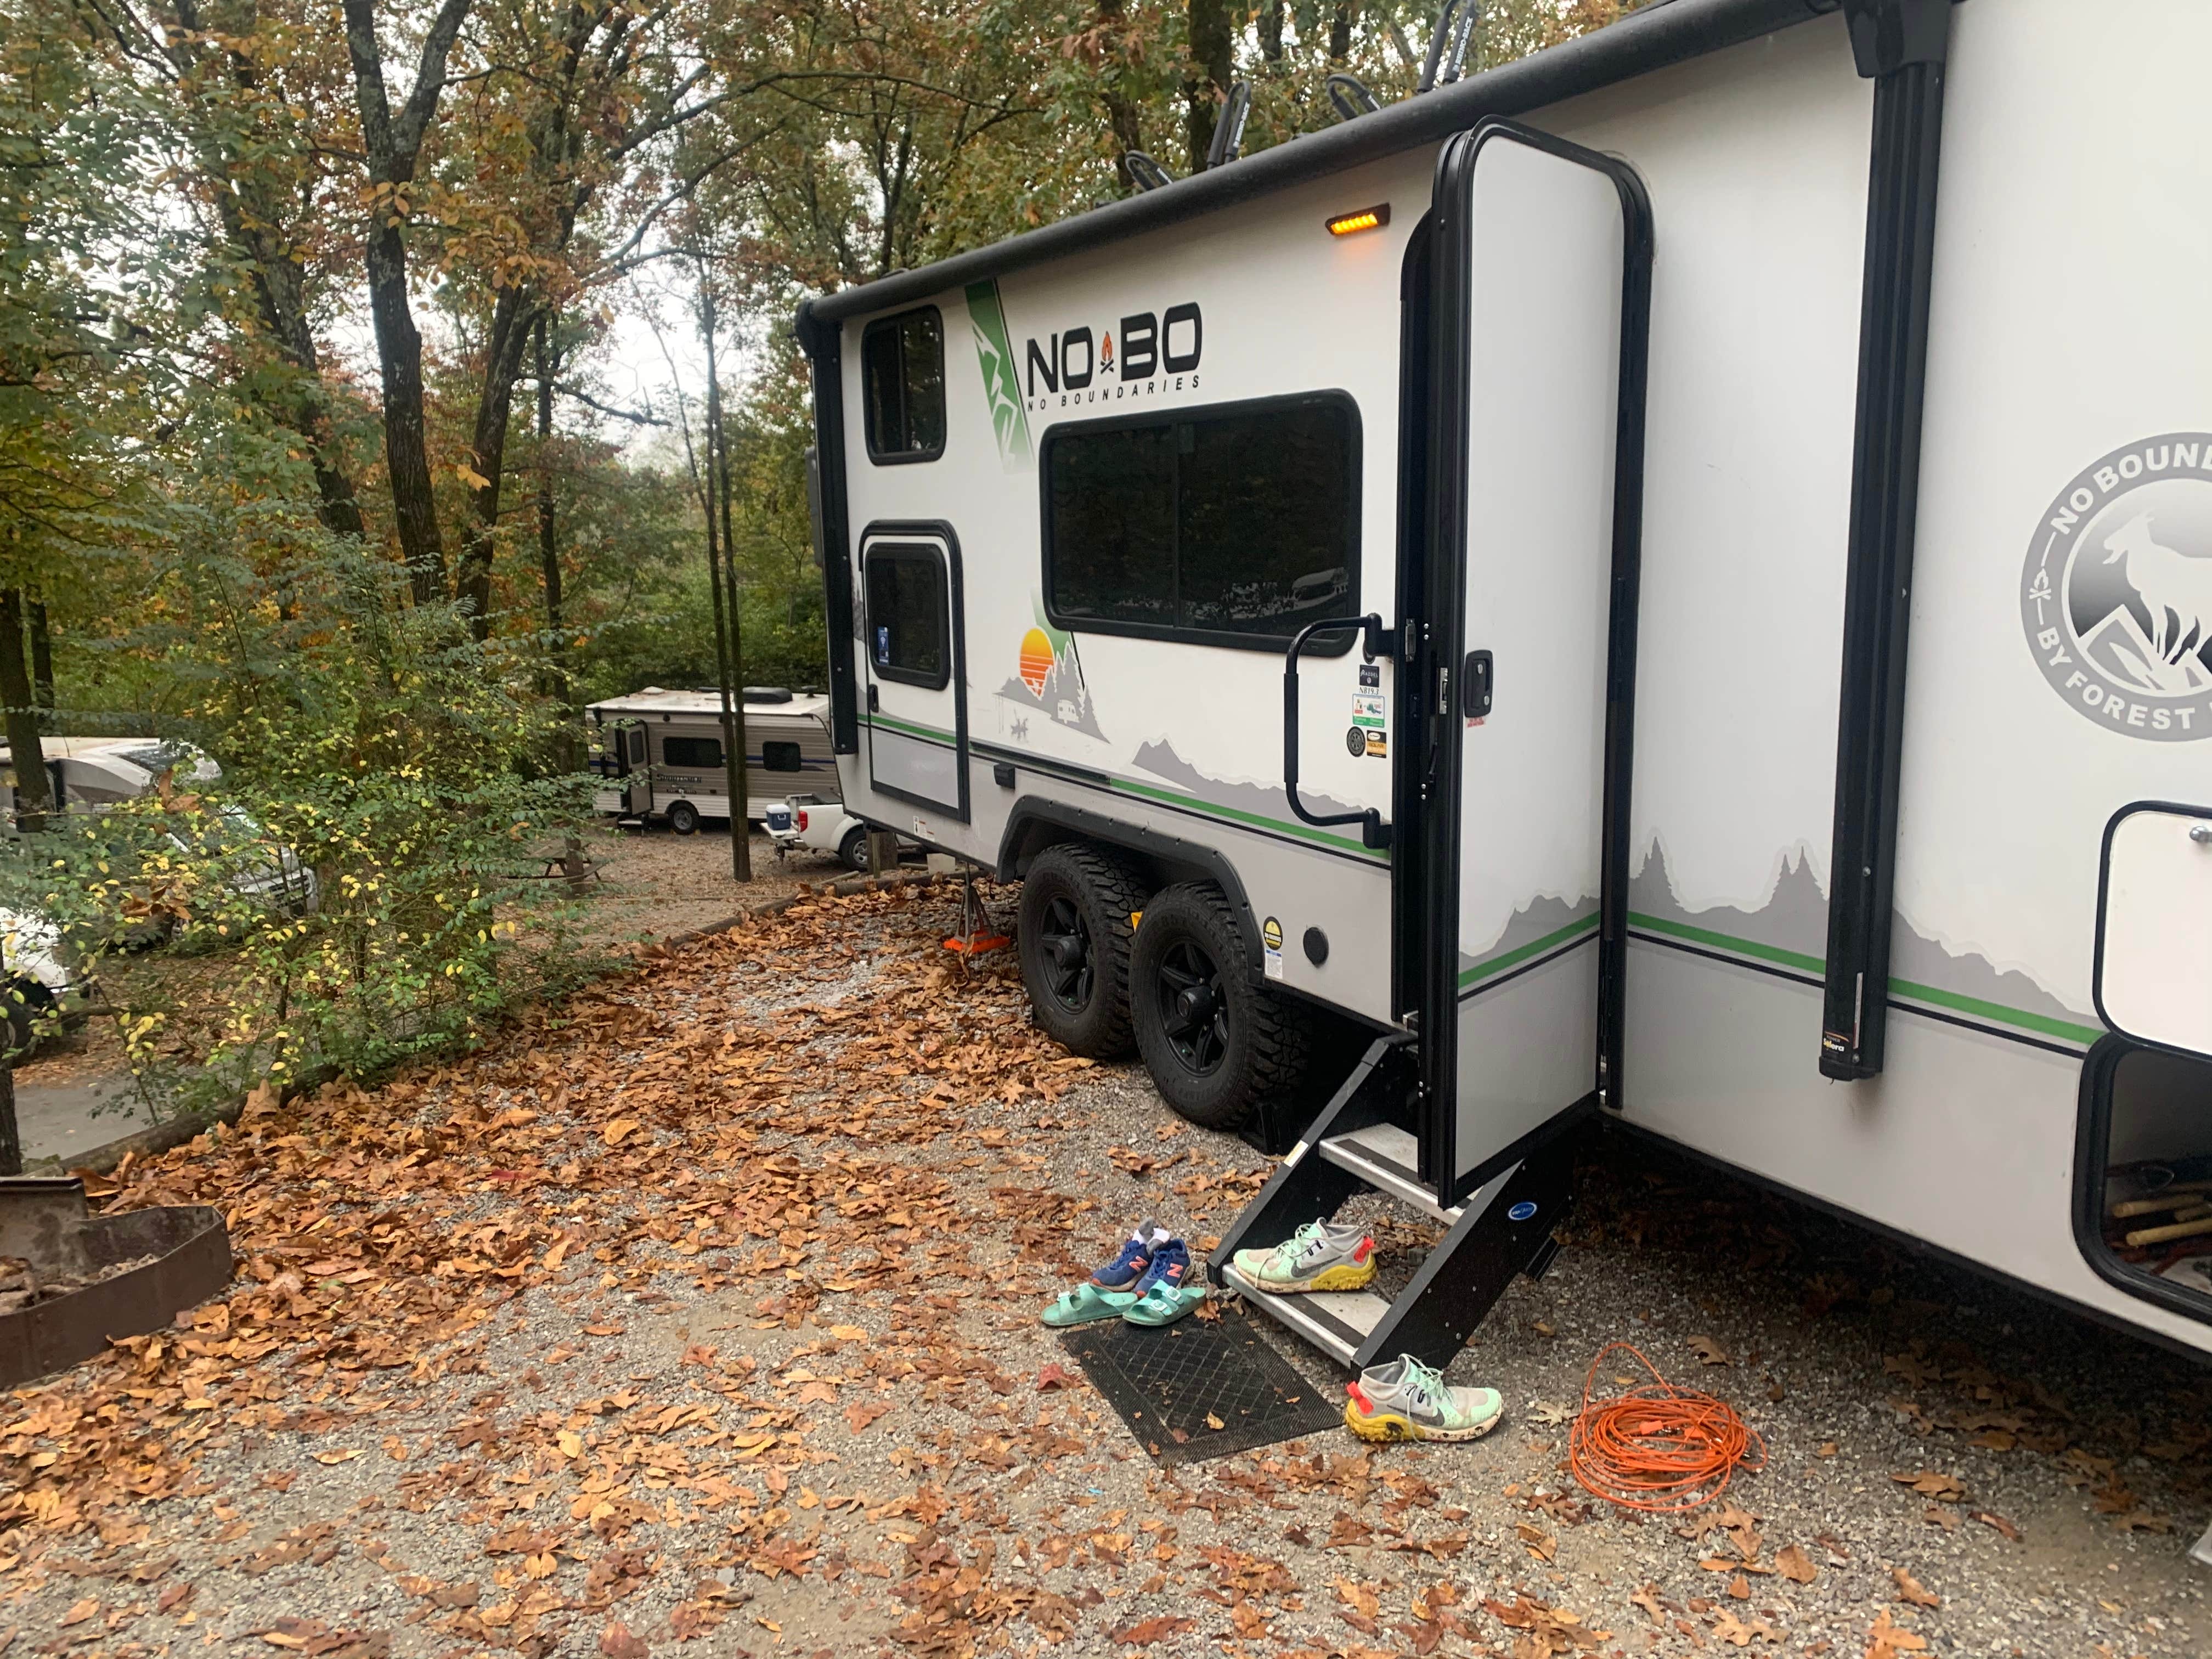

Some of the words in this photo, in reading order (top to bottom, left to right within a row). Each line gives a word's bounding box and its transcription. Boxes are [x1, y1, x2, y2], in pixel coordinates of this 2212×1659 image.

[1027, 326, 1093, 397] NO
[1120, 302, 1203, 382] BO
[1027, 398, 1046, 412] NO
[1061, 374, 1199, 407] BOUNDARIES
[2050, 487, 2094, 535] NO
[1359, 687, 1379, 695] NB19.3
[2037, 627, 2073, 667] BY
[2065, 670, 2196, 730] FOREST
[1823, 1037, 1845, 1052] Solera
